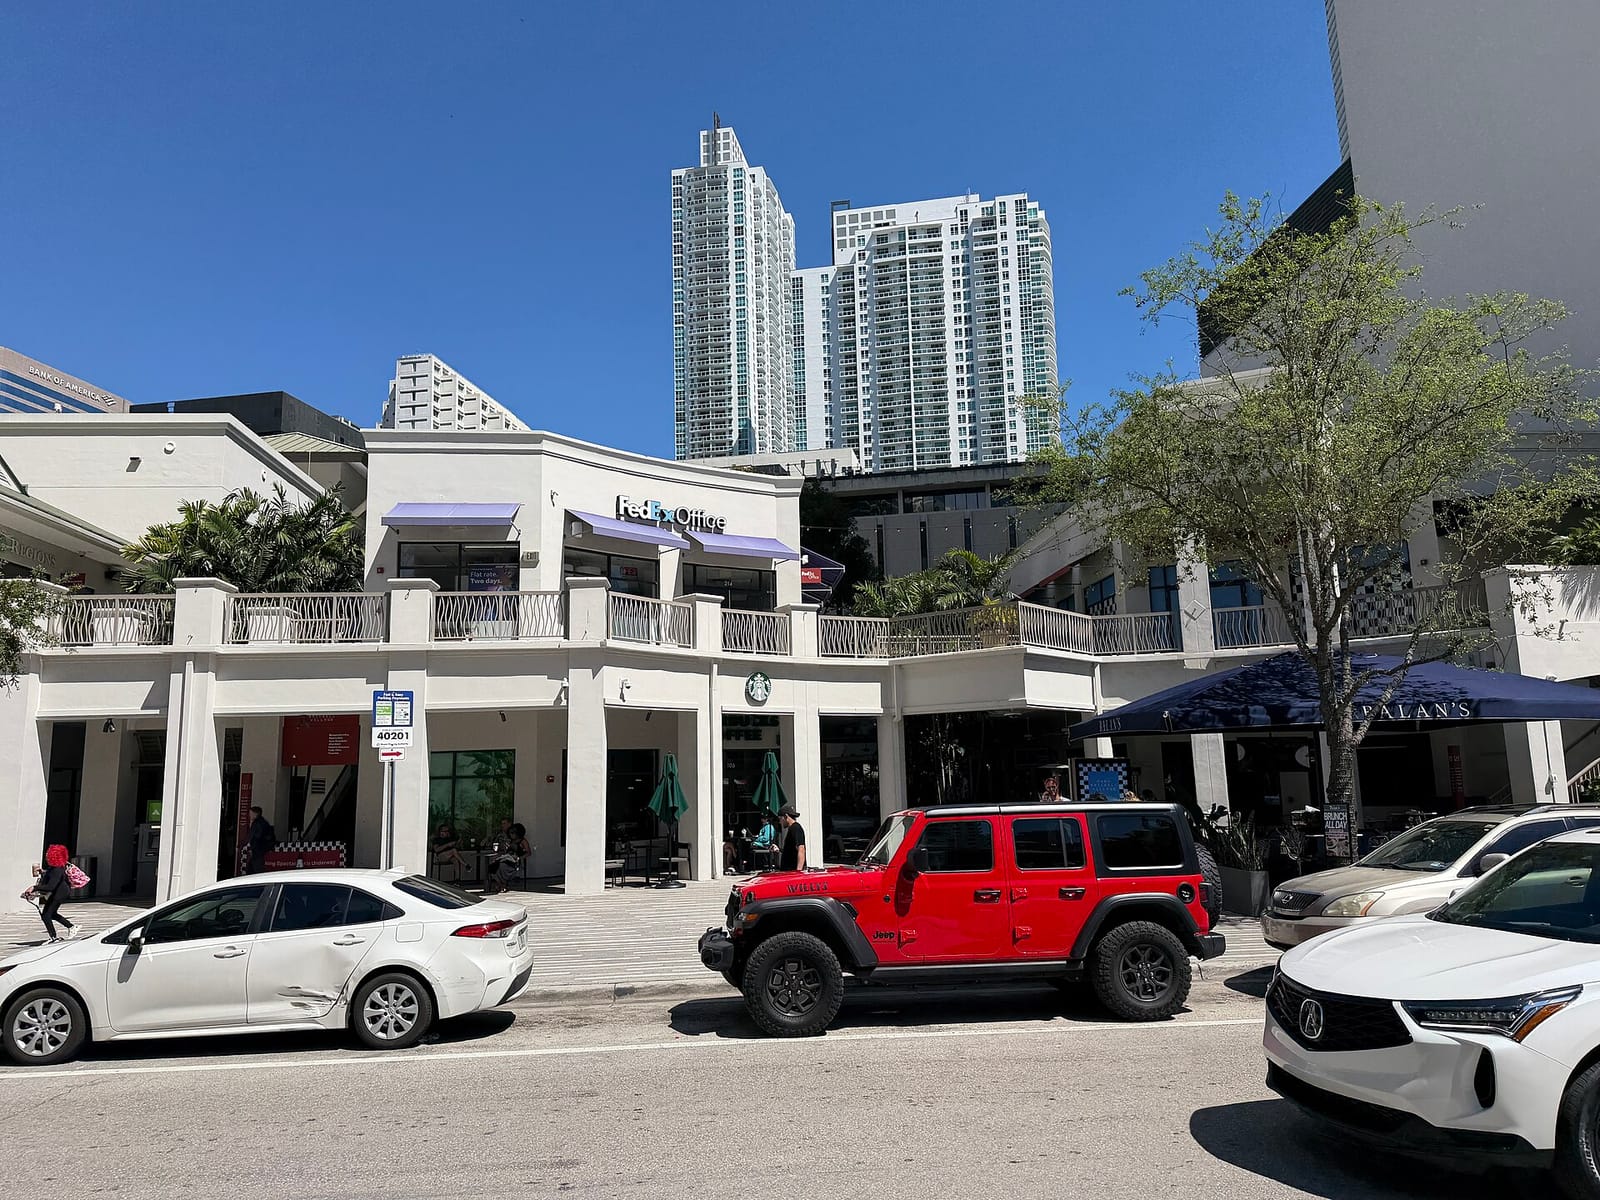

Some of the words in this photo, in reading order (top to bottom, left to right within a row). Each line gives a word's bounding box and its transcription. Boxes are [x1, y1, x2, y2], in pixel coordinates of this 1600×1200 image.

[28, 366, 52, 382] BANK
[53, 376, 64, 386] OF
[65, 382, 100, 402] AMERICA
[616, 494, 675, 522] FedEx
[676, 506, 728, 529] Office
[526, 552, 537, 560] EXIT
[377, 732, 409, 740] 40201
[1324, 812, 1348, 821] BRUNCH
[1335, 820, 1346, 829] DAY
[788, 882, 828, 893] WILLYS
[872, 931, 895, 939] Jeep
